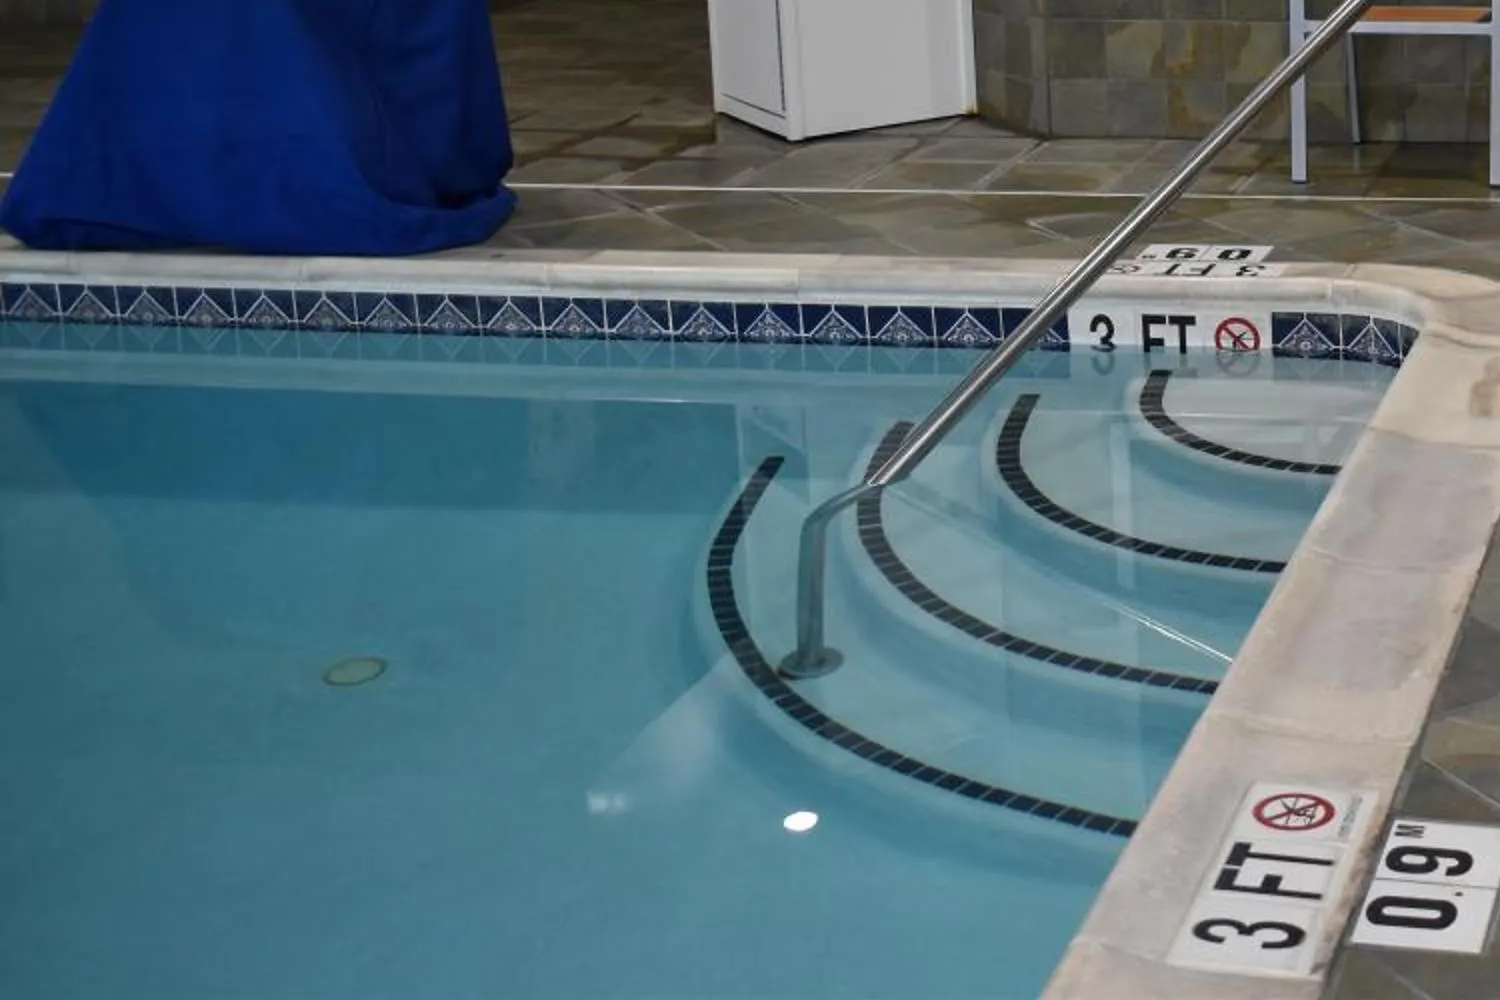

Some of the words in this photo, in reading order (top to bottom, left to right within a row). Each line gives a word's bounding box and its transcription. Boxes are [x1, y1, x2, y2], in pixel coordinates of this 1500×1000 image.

[1090, 313, 1116, 351] 3
[1141, 313, 1197, 353] FT
[1214, 841, 1335, 900] FT
[1192, 917, 1307, 950] 3
